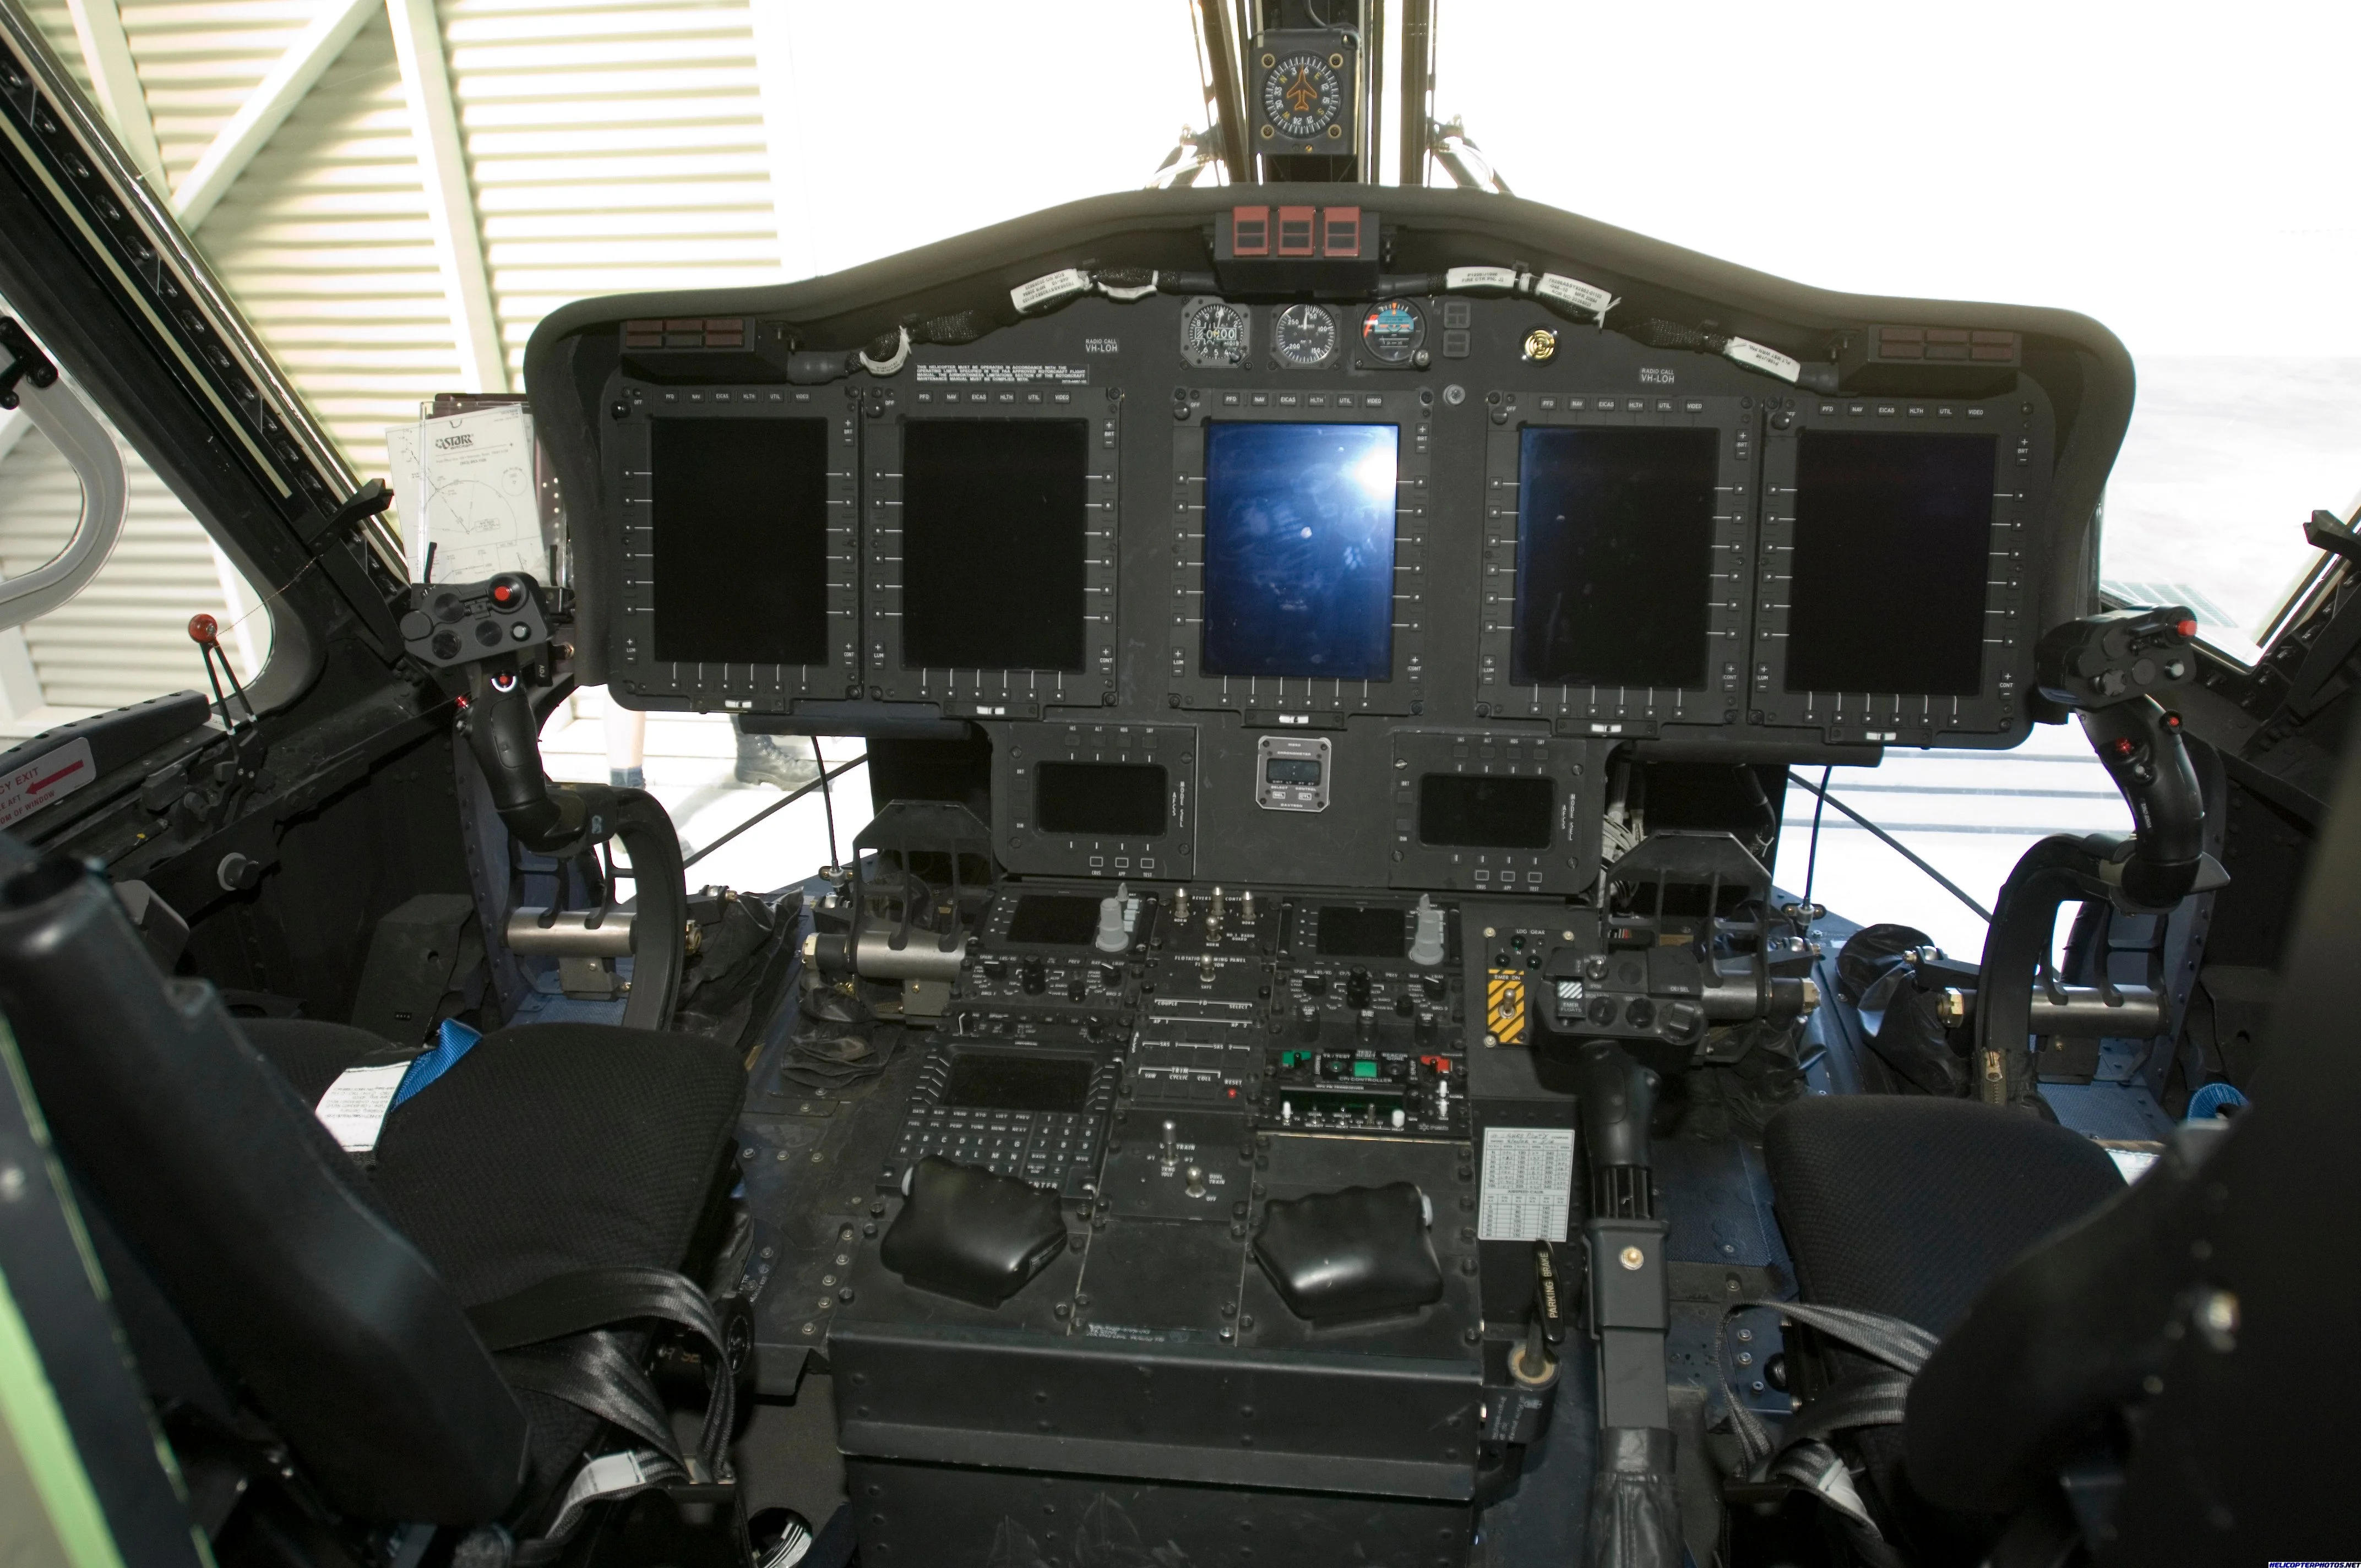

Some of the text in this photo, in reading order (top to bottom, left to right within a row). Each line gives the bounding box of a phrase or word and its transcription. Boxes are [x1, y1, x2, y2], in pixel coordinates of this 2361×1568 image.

[1292, 68, 1297, 76] 3
[1279, 75, 1288, 84] N
[1274, 86, 1282, 96] 33
[1321, 83, 1330, 91] 12
[1275, 100, 1283, 109] 30
[1293, 116, 1302, 124] 24
[1307, 116, 1314, 124] 21
[1085, 344, 1118, 352] VH-LOH
[1641, 374, 1675, 383] VH-LOH
[15, 767, 39, 786] EXIT
[8, 794, 21, 806] AFT
[14, 790, 55, 816] OF WINDOW
[1538, 1251, 1558, 1318] PARKING BRAKE
